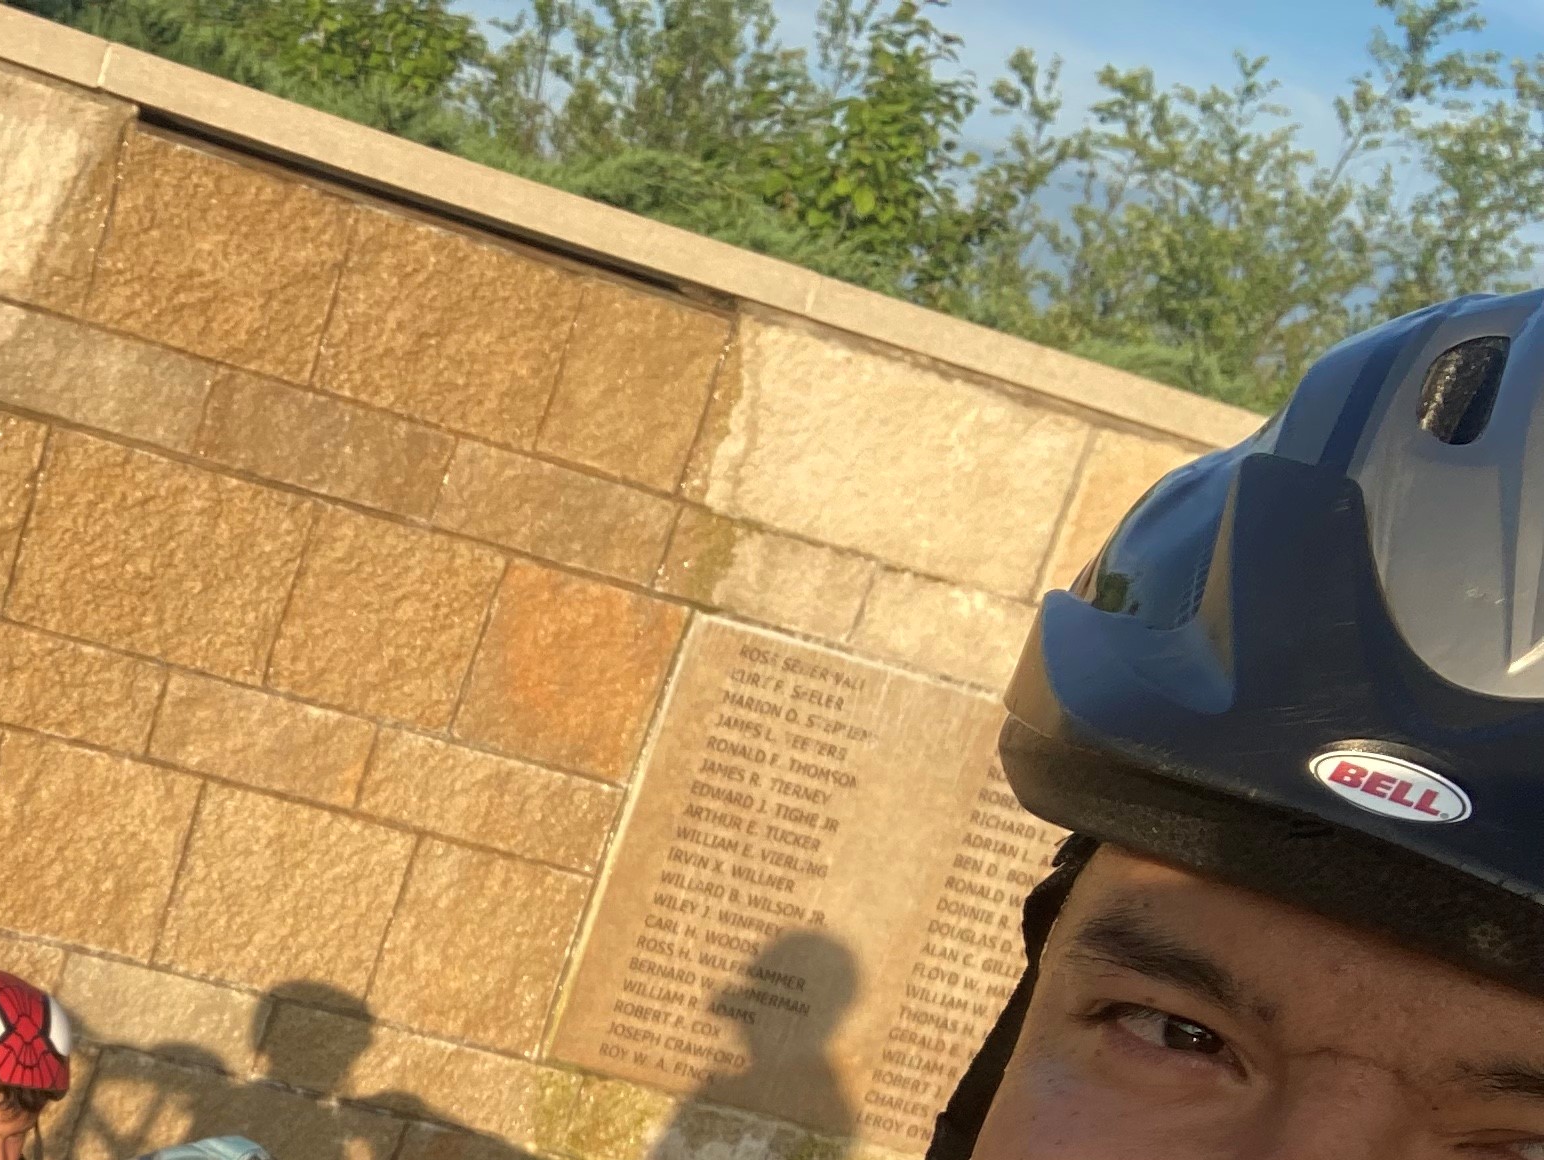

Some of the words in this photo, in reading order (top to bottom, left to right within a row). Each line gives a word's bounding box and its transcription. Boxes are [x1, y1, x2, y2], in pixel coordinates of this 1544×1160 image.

[714, 713, 763, 737] JAMES
[706, 736, 766, 763] RONALD
[787, 758, 859, 788] THOMSON
[698, 758, 746, 782] JAMES
[768, 777, 831, 805] TIERNEY
[1328, 761, 1441, 817] BELL
[690, 781, 754, 809] EDWARD
[772, 803, 819, 826] TIGHE
[682, 803, 742, 830] ARTHUR
[763, 825, 821, 851] TUCKER
[970, 810, 1037, 838] RICHARD
[674, 826, 738, 854] WILLIAM
[758, 848, 829, 878] VIERLING
[963, 832, 1019, 858] ADRIAN
[666, 848, 709, 870] IRVIN
[730, 865, 796, 892] WILLNER
[953, 854, 983, 873] BEN
[658, 870, 725, 898] WILLARD
[745, 893, 805, 919] WILSON
[944, 876, 1006, 903] RONALD
[651, 892, 698, 915] WILEY
[716, 909, 784, 937] WINFREY
[936, 897, 995, 923] DONNIE
[634, 936, 675, 957] ROSS
[643, 914, 680, 934] CARL
[703, 930, 760, 955] WOODS
[927, 919, 998, 948] DOUGLAS
[921, 942, 959, 962] ALAN
[627, 957, 696, 986] BERNARD
[912, 962, 960, 985] FLOYD
[620, 979, 682, 1005] WILLIAM
[708, 1001, 757, 1024] ADAMS
[904, 984, 968, 1011] WILLIAM
[613, 1000, 671, 1025] ROBERT
[690, 1019, 721, 1037] COX
[897, 1006, 959, 1033] THOMAS
[606, 1022, 661, 1046] JOSEPH
[663, 1036, 747, 1067] CRAWFORD
[888, 1027, 947, 1052] GERALD
[598, 1043, 627, 1061] ROY
[672, 1061, 716, 1082] FINCK
[880, 1049, 944, 1074] WILLIAM
[872, 1069, 929, 1093] ROBERT
[864, 1090, 930, 1116] CHARLES
[855, 1111, 905, 1133] LEROY
